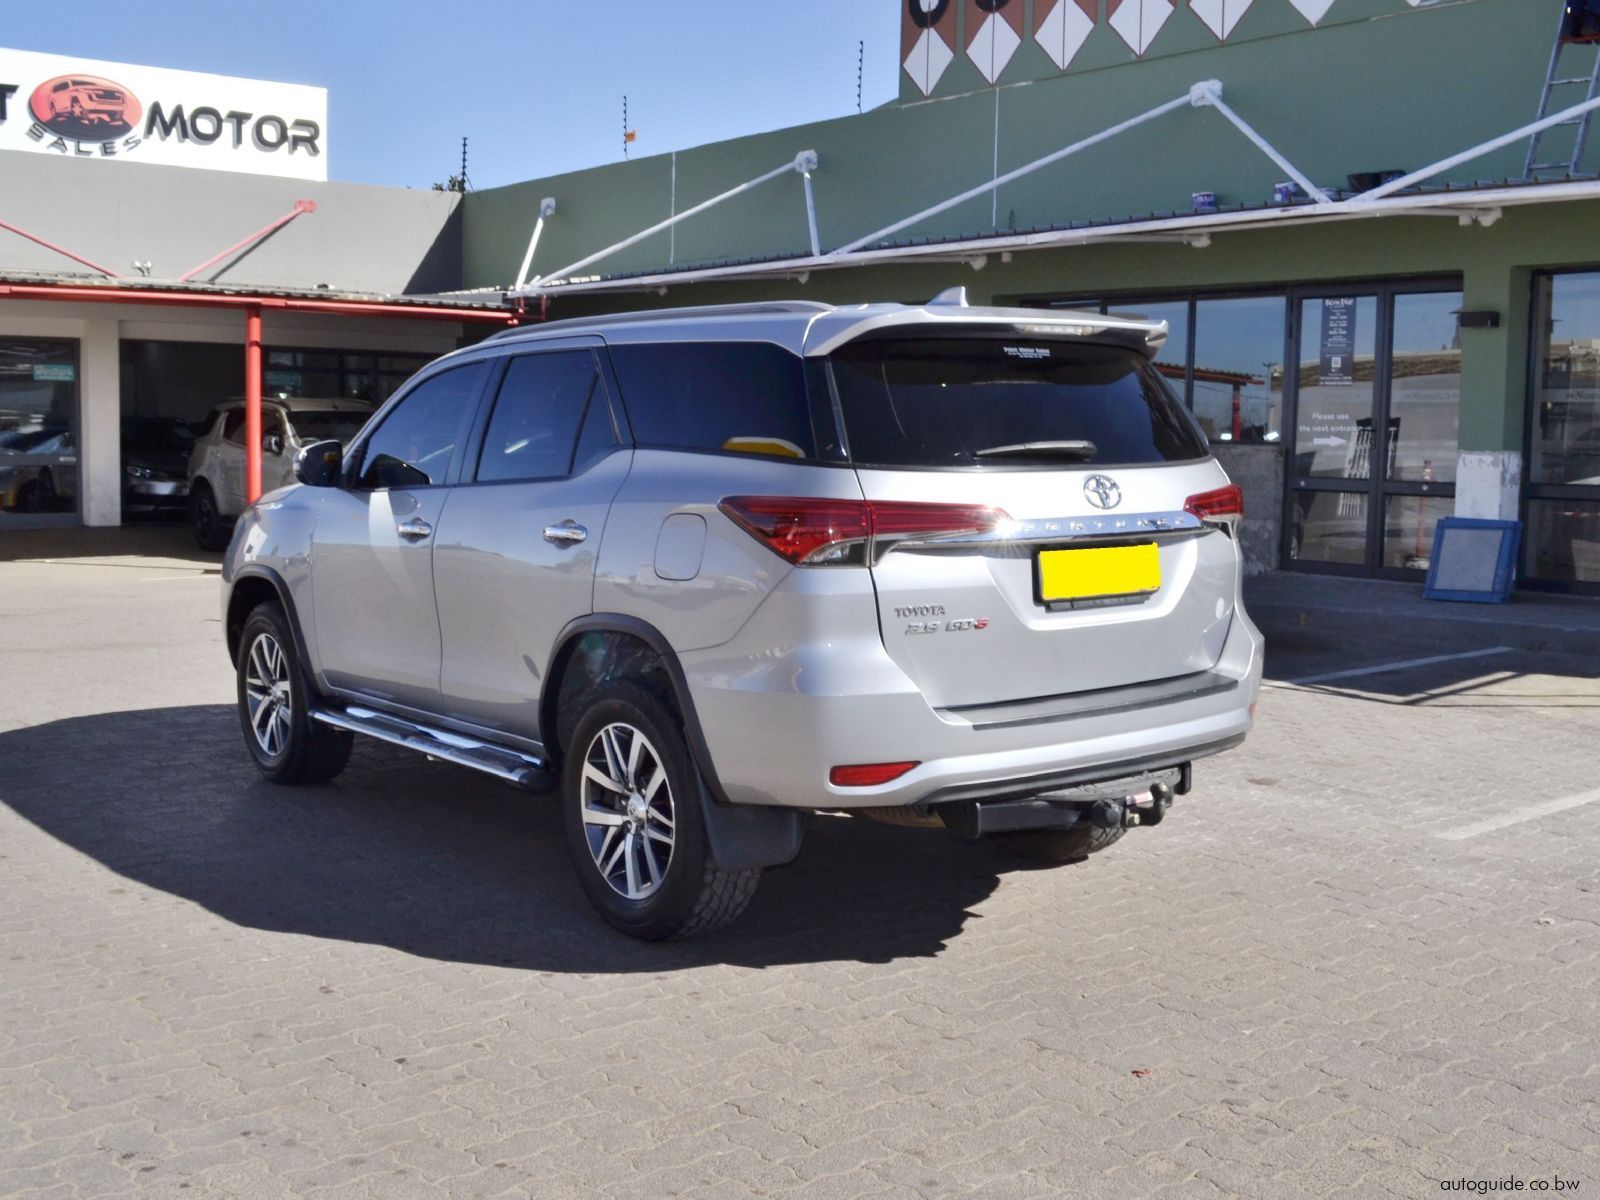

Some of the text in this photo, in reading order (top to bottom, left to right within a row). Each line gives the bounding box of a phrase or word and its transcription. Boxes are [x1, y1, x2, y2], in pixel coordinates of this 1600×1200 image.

[25, 121, 142, 156] SALES
[143, 100, 321, 157] MOTOR
[1312, 412, 1334, 420] Please
[894, 604, 946, 618] TOYOTA
